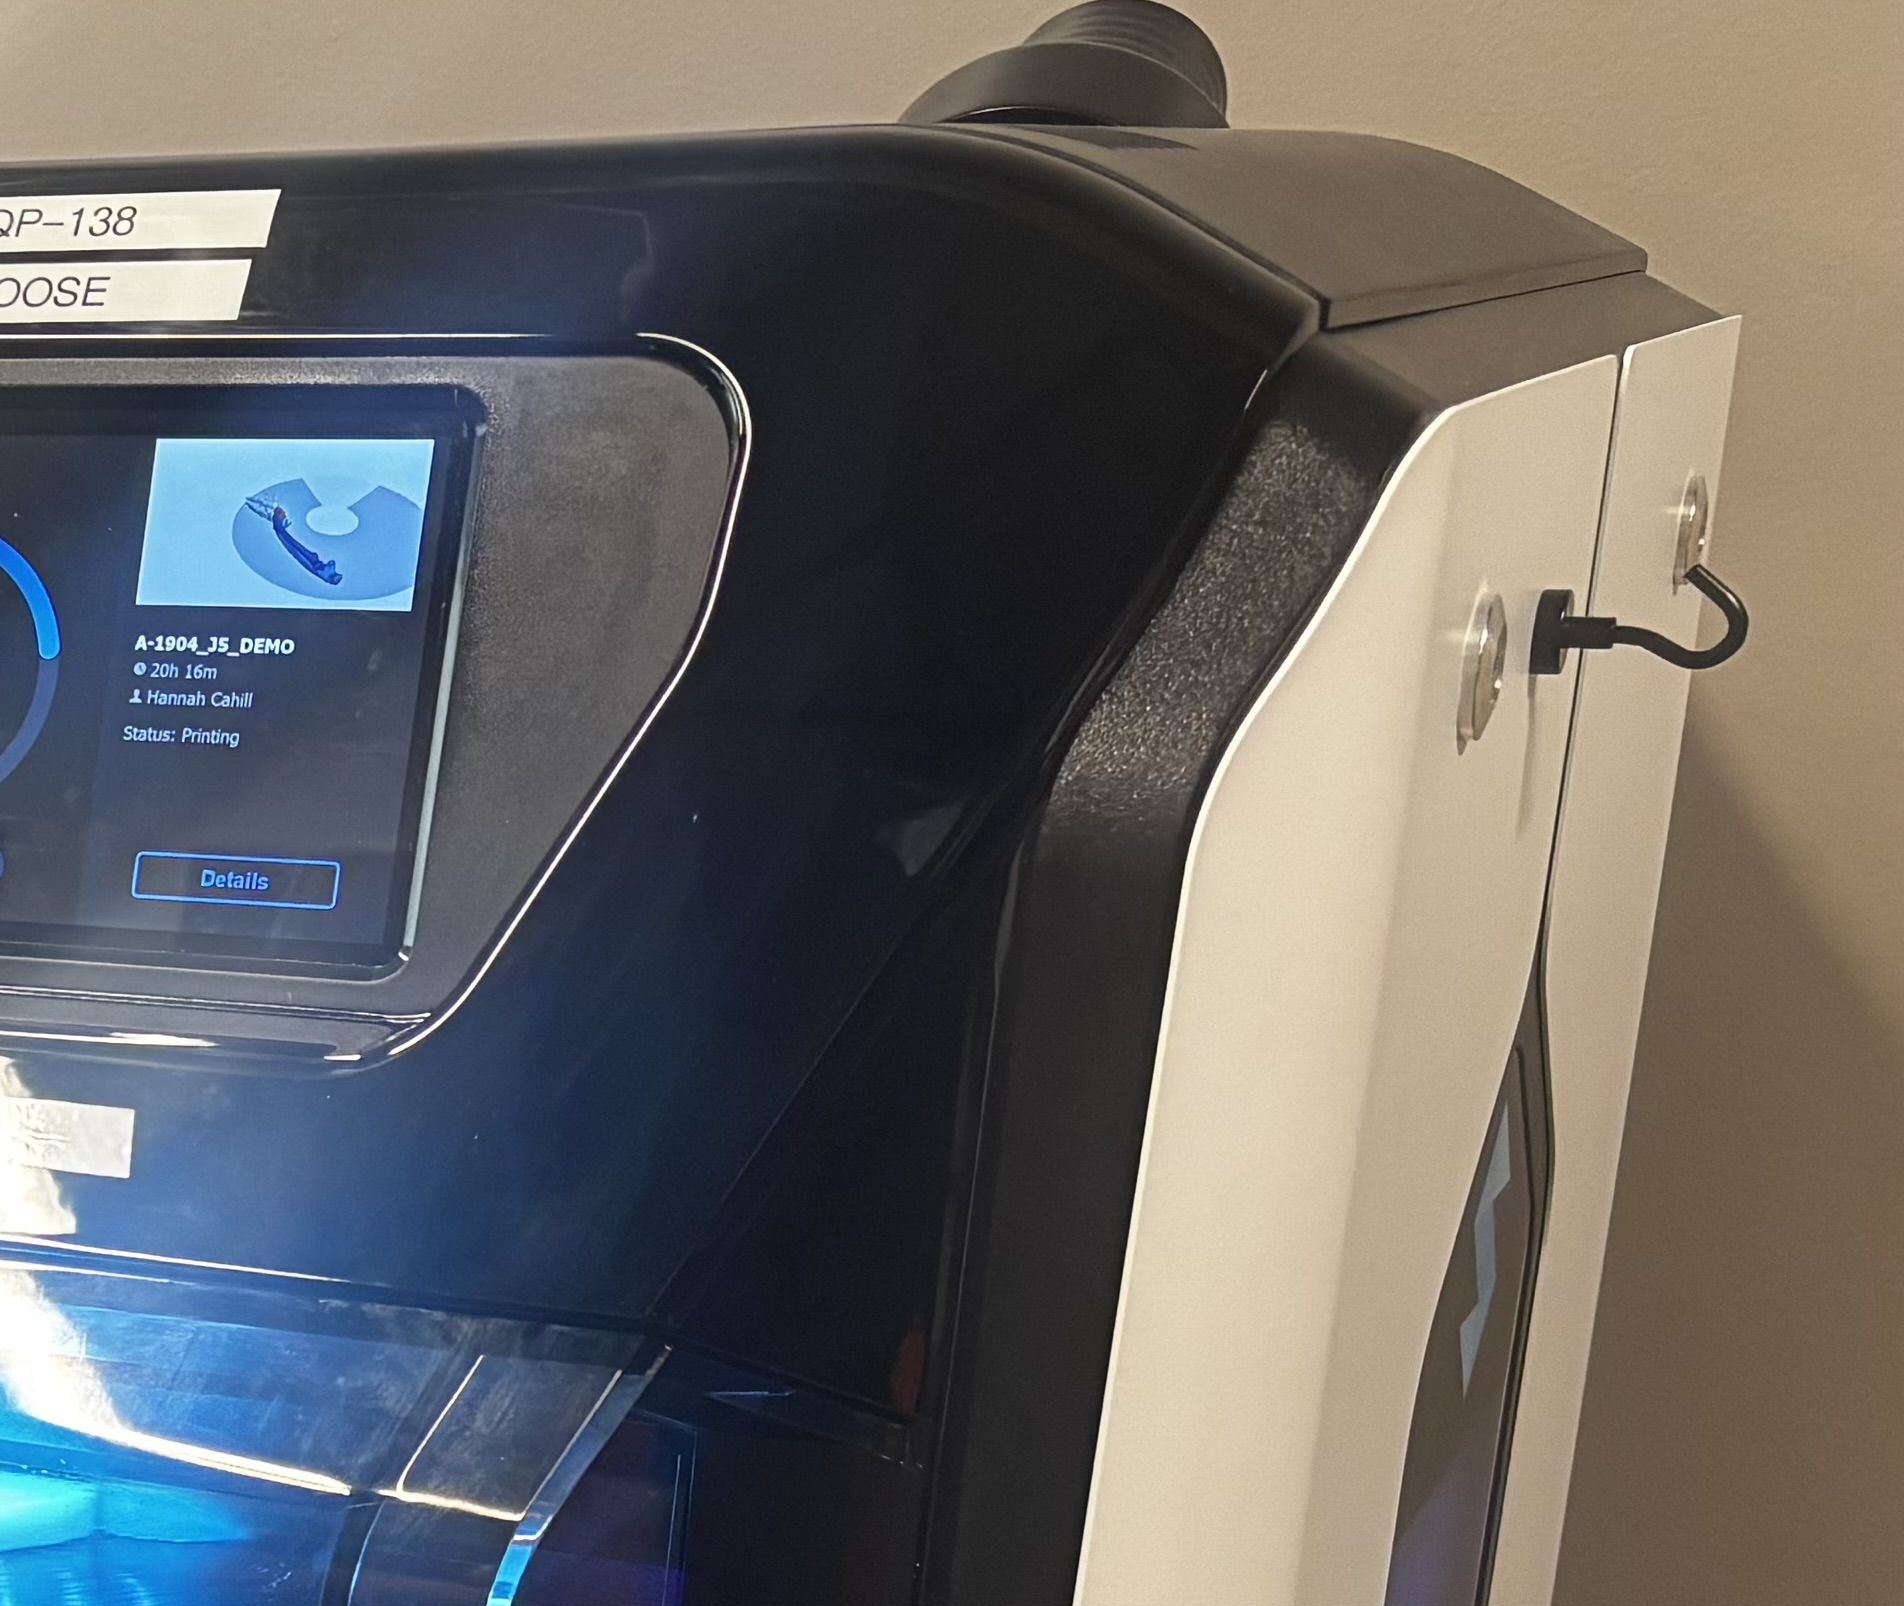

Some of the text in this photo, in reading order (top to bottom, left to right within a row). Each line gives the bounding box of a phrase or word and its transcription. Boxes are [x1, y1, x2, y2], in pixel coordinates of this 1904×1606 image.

[134, 634, 296, 657] A-1904_J5_DEMO
[149, 662, 218, 680] 20h 16m
[146, 689, 254, 708] Hannah Cahill
[122, 725, 241, 749] Status: Printing
[200, 868, 270, 890] Details
